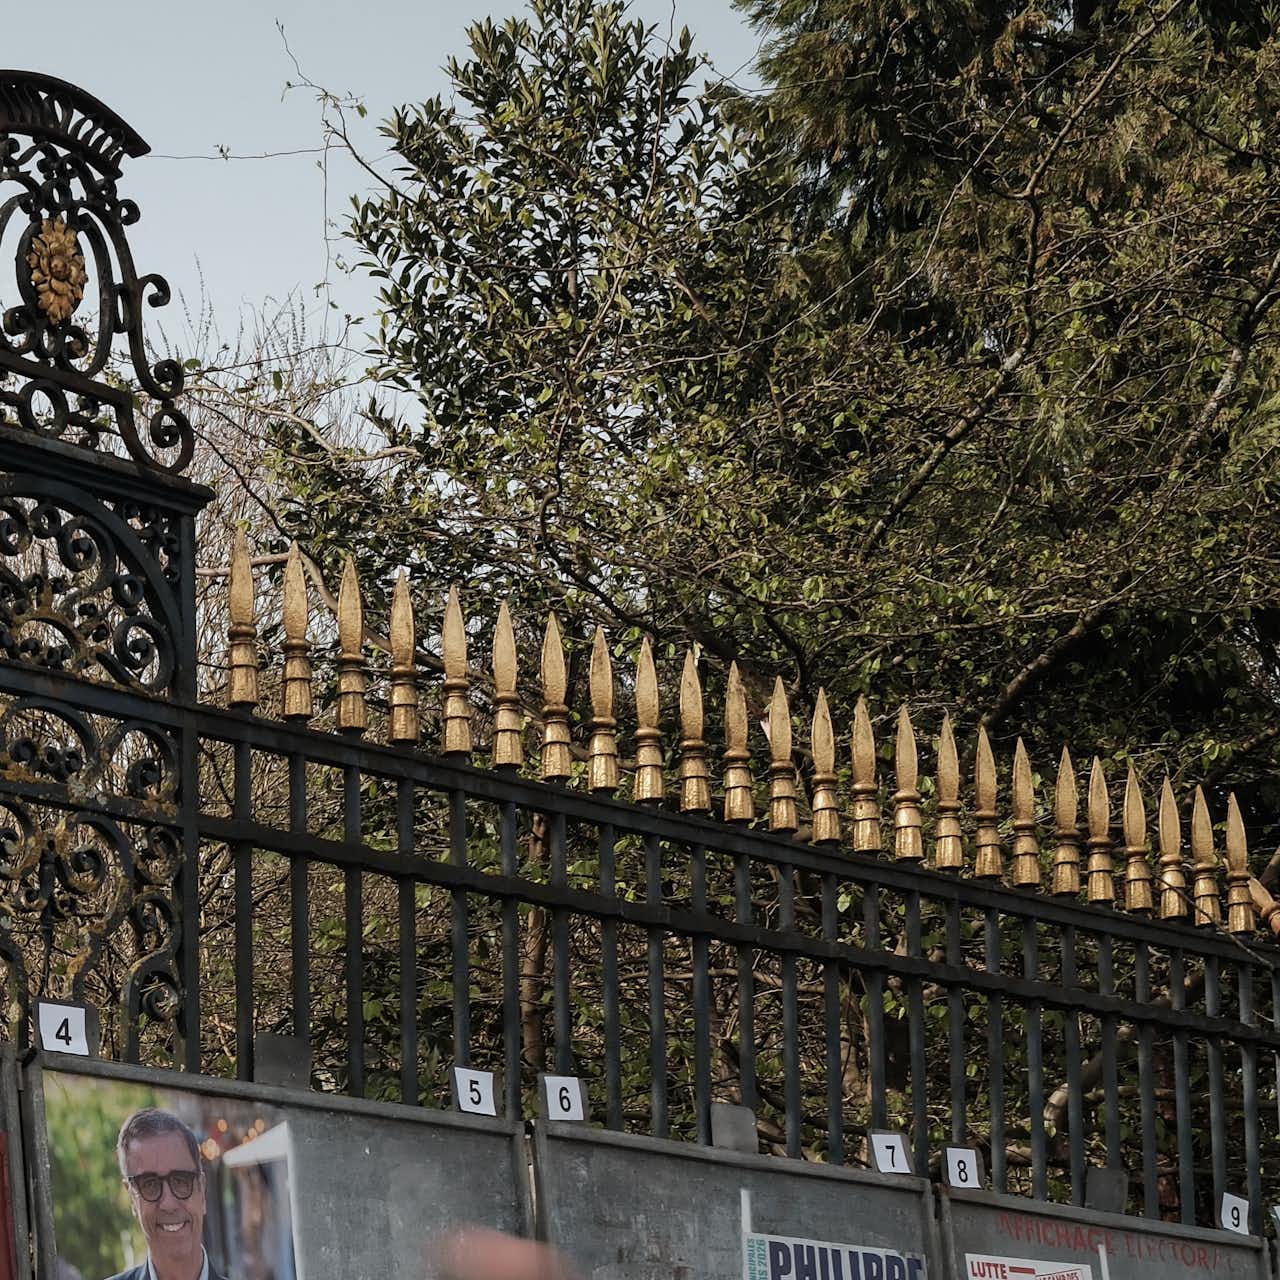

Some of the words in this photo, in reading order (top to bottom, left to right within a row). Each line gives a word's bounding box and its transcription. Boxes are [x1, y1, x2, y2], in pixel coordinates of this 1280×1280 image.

[54, 1017, 72, 1045] 4
[469, 1079, 482, 1106] 5
[558, 1086, 572, 1112] 6
[885, 1145, 896, 1168] 7
[957, 1159, 969, 1183] 8
[1230, 1206, 1241, 1228] 9
[970, 1261, 1008, 1280] LUTTE
